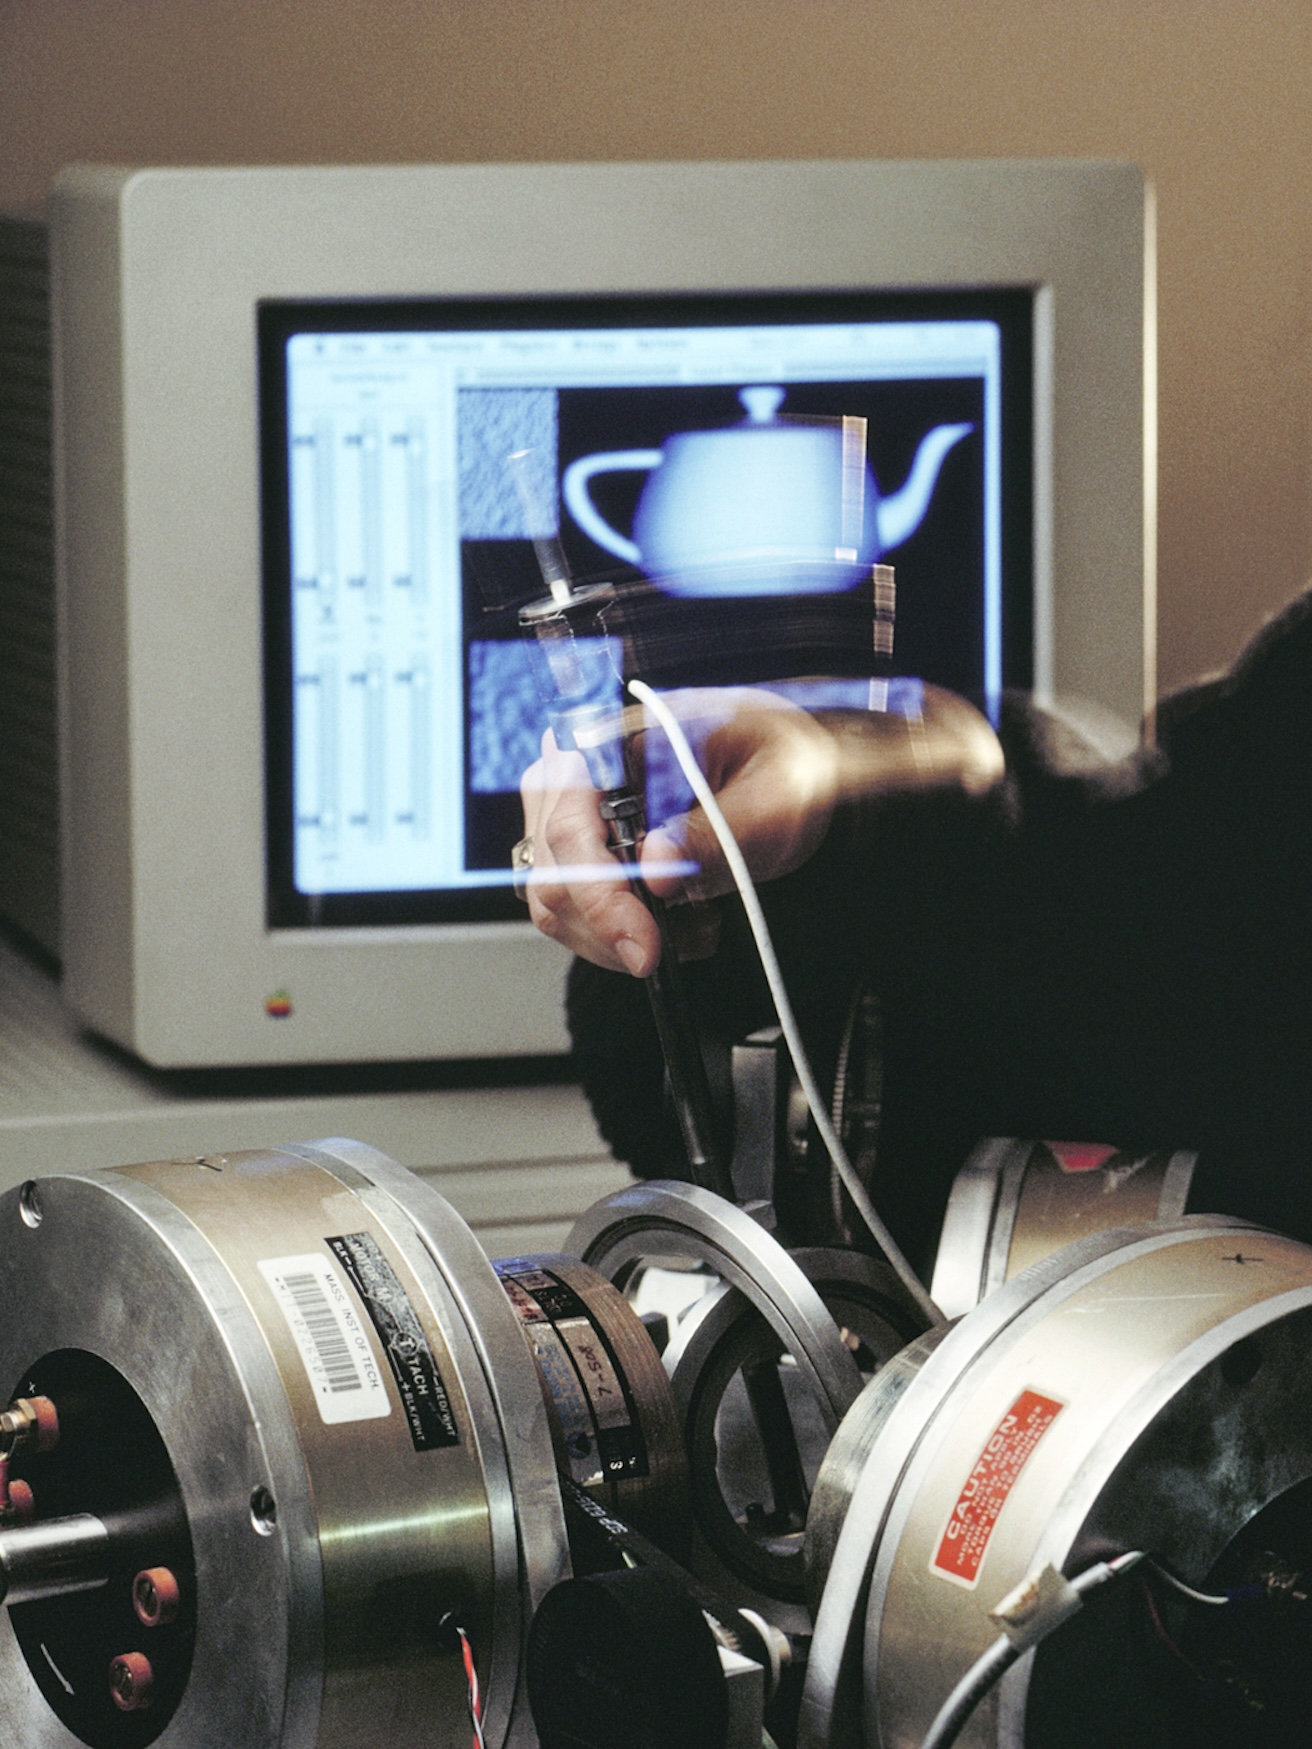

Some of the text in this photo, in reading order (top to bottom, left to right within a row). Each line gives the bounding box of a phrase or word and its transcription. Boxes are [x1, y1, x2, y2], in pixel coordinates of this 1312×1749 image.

[349, 1242, 380, 1284] MOTOR
[342, 1308, 360, 1332] INST
[355, 1337, 369, 1352] OF
[407, 1355, 429, 1396] TACH
[947, 1413, 1018, 1541] CAUTION
[971, 1478, 988, 1508] NOT
[990, 1427, 1017, 1471] APPLY
[956, 1522, 976, 1566] MORE
[976, 1475, 999, 1514] THAN
[967, 1496, 995, 1554] TORQUE
[995, 1470, 1010, 1488] TO
